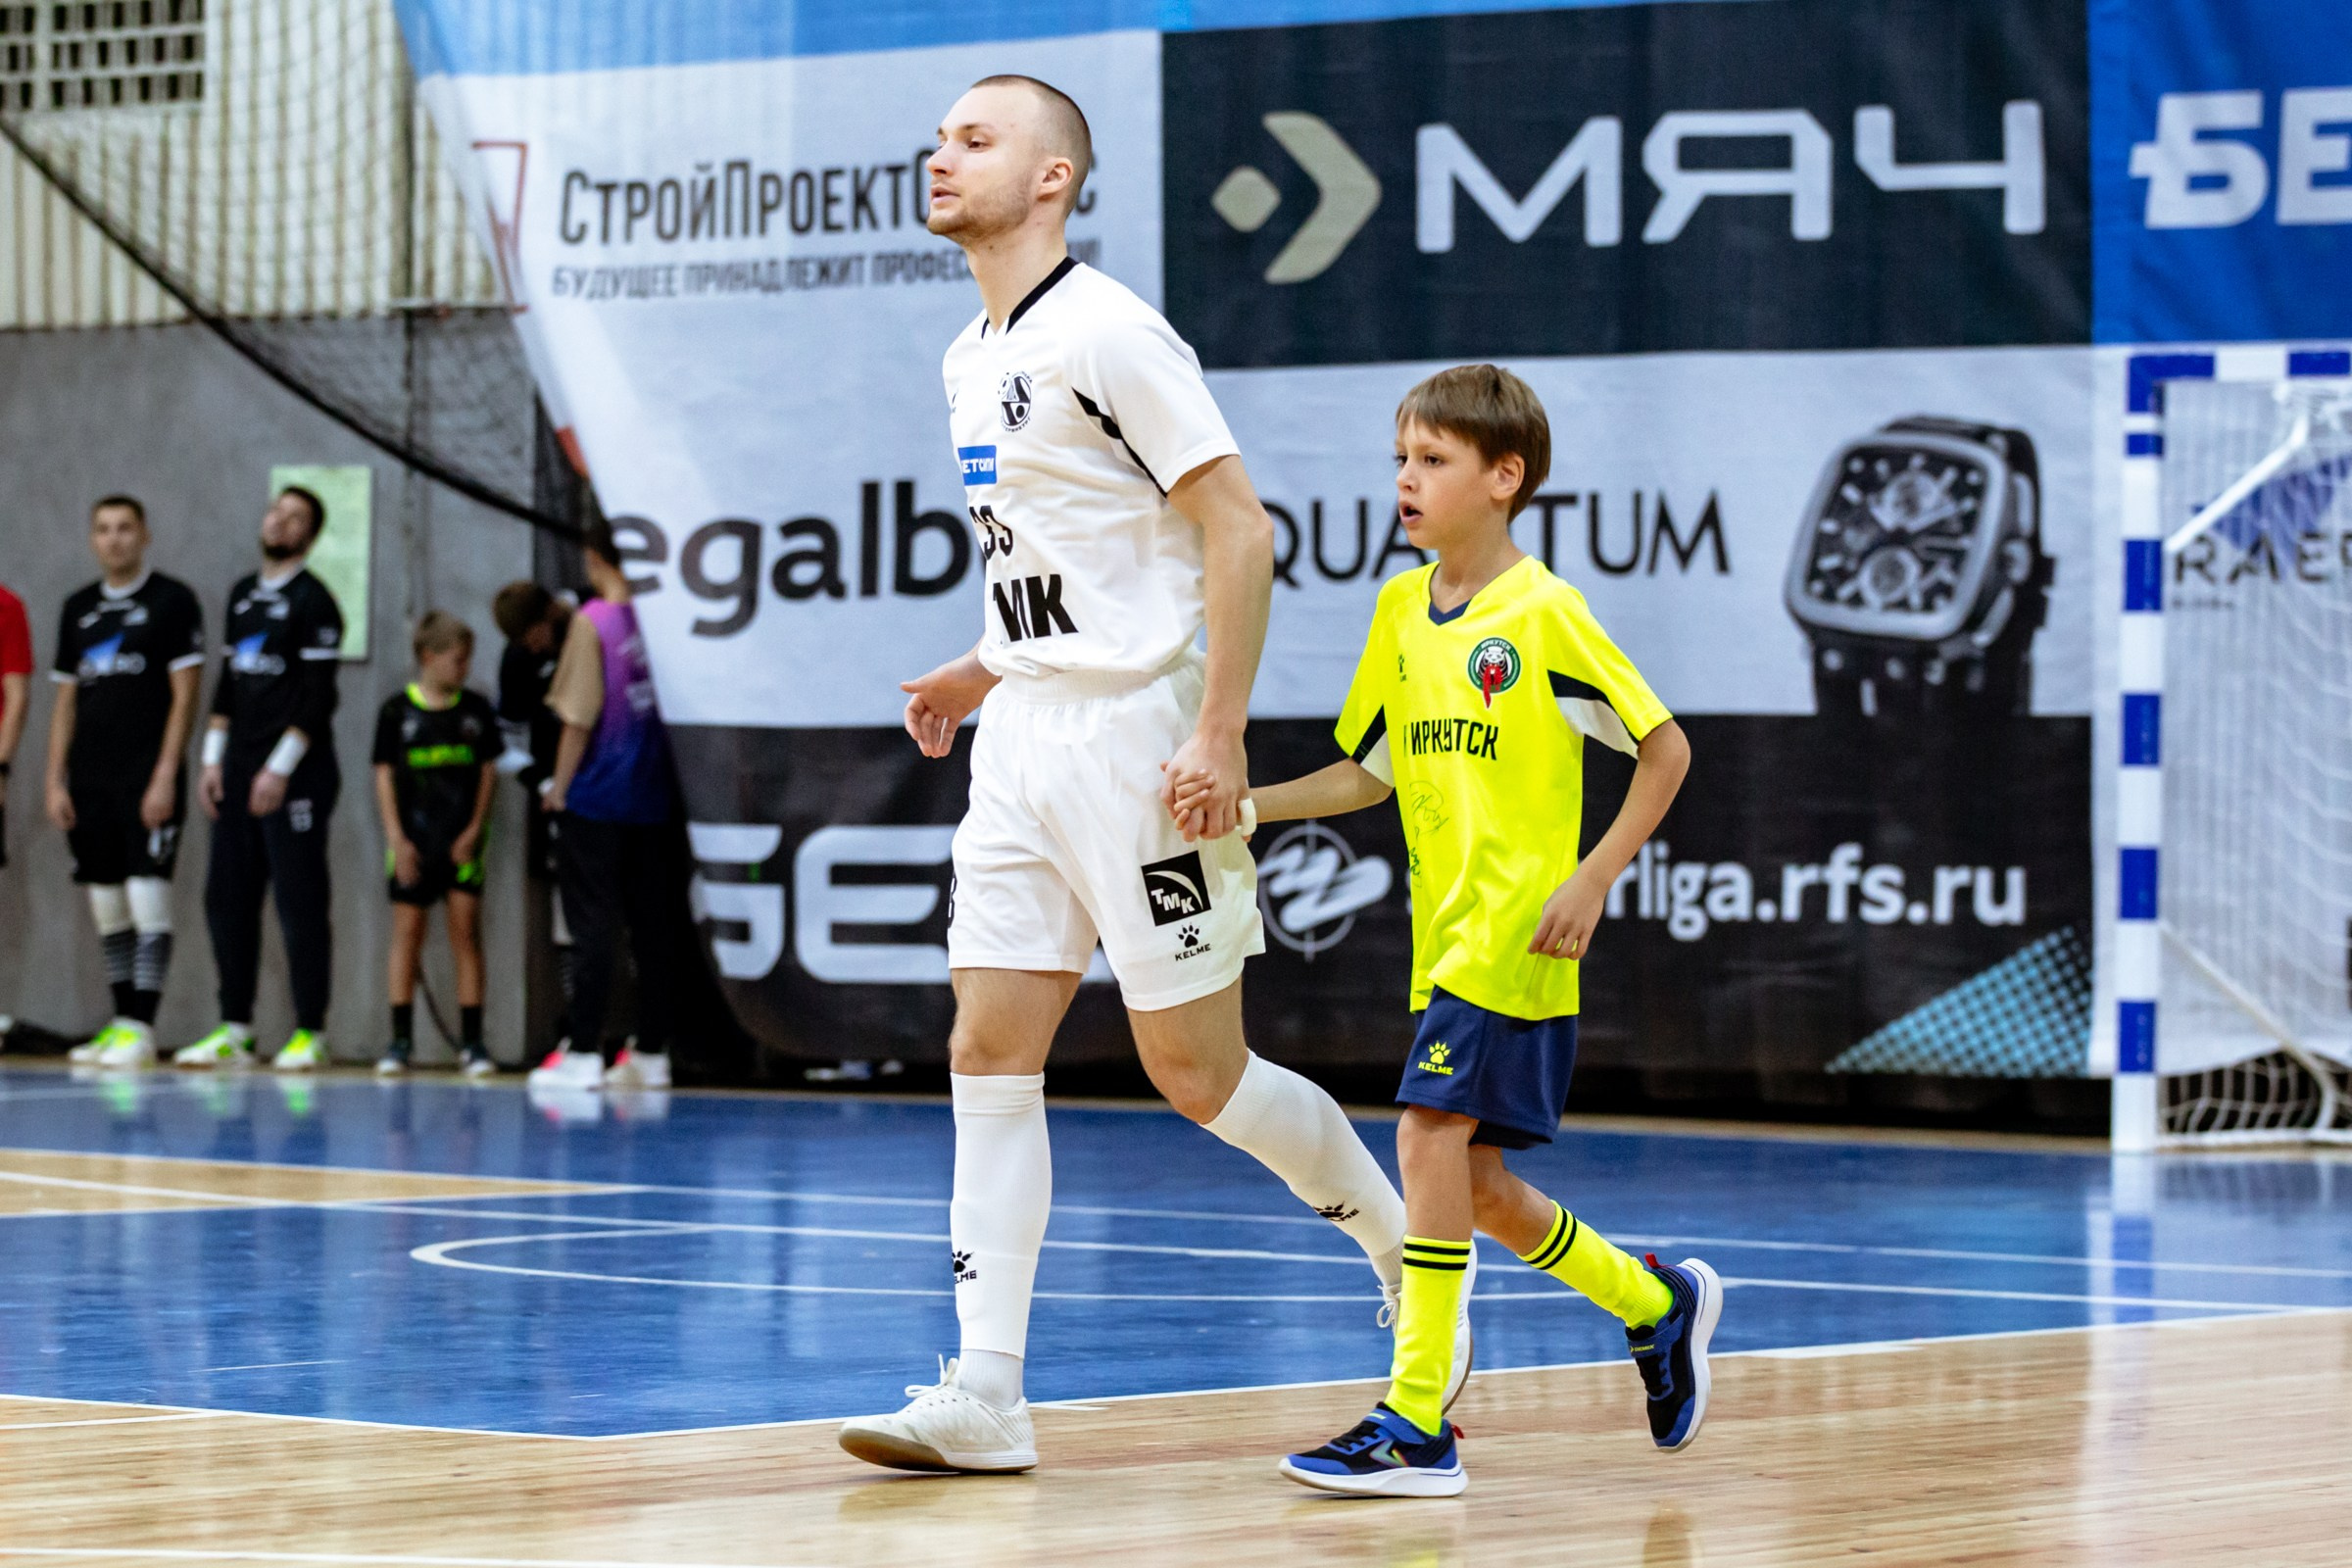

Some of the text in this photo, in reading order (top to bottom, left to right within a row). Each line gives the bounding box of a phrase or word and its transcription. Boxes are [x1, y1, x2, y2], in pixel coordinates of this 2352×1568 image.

[1416, 100, 2044, 253] МЯЧ
[552, 265, 678, 300] БУДУЩЕЕ
[605, 479, 986, 637] egalb
[1410, 717, 1499, 761] ИРКУТСК
[1605, 840, 2028, 941] rliga.rfs.ru
[1174, 943, 1211, 961] KELME
[1417, 1060, 1454, 1076] KELME
